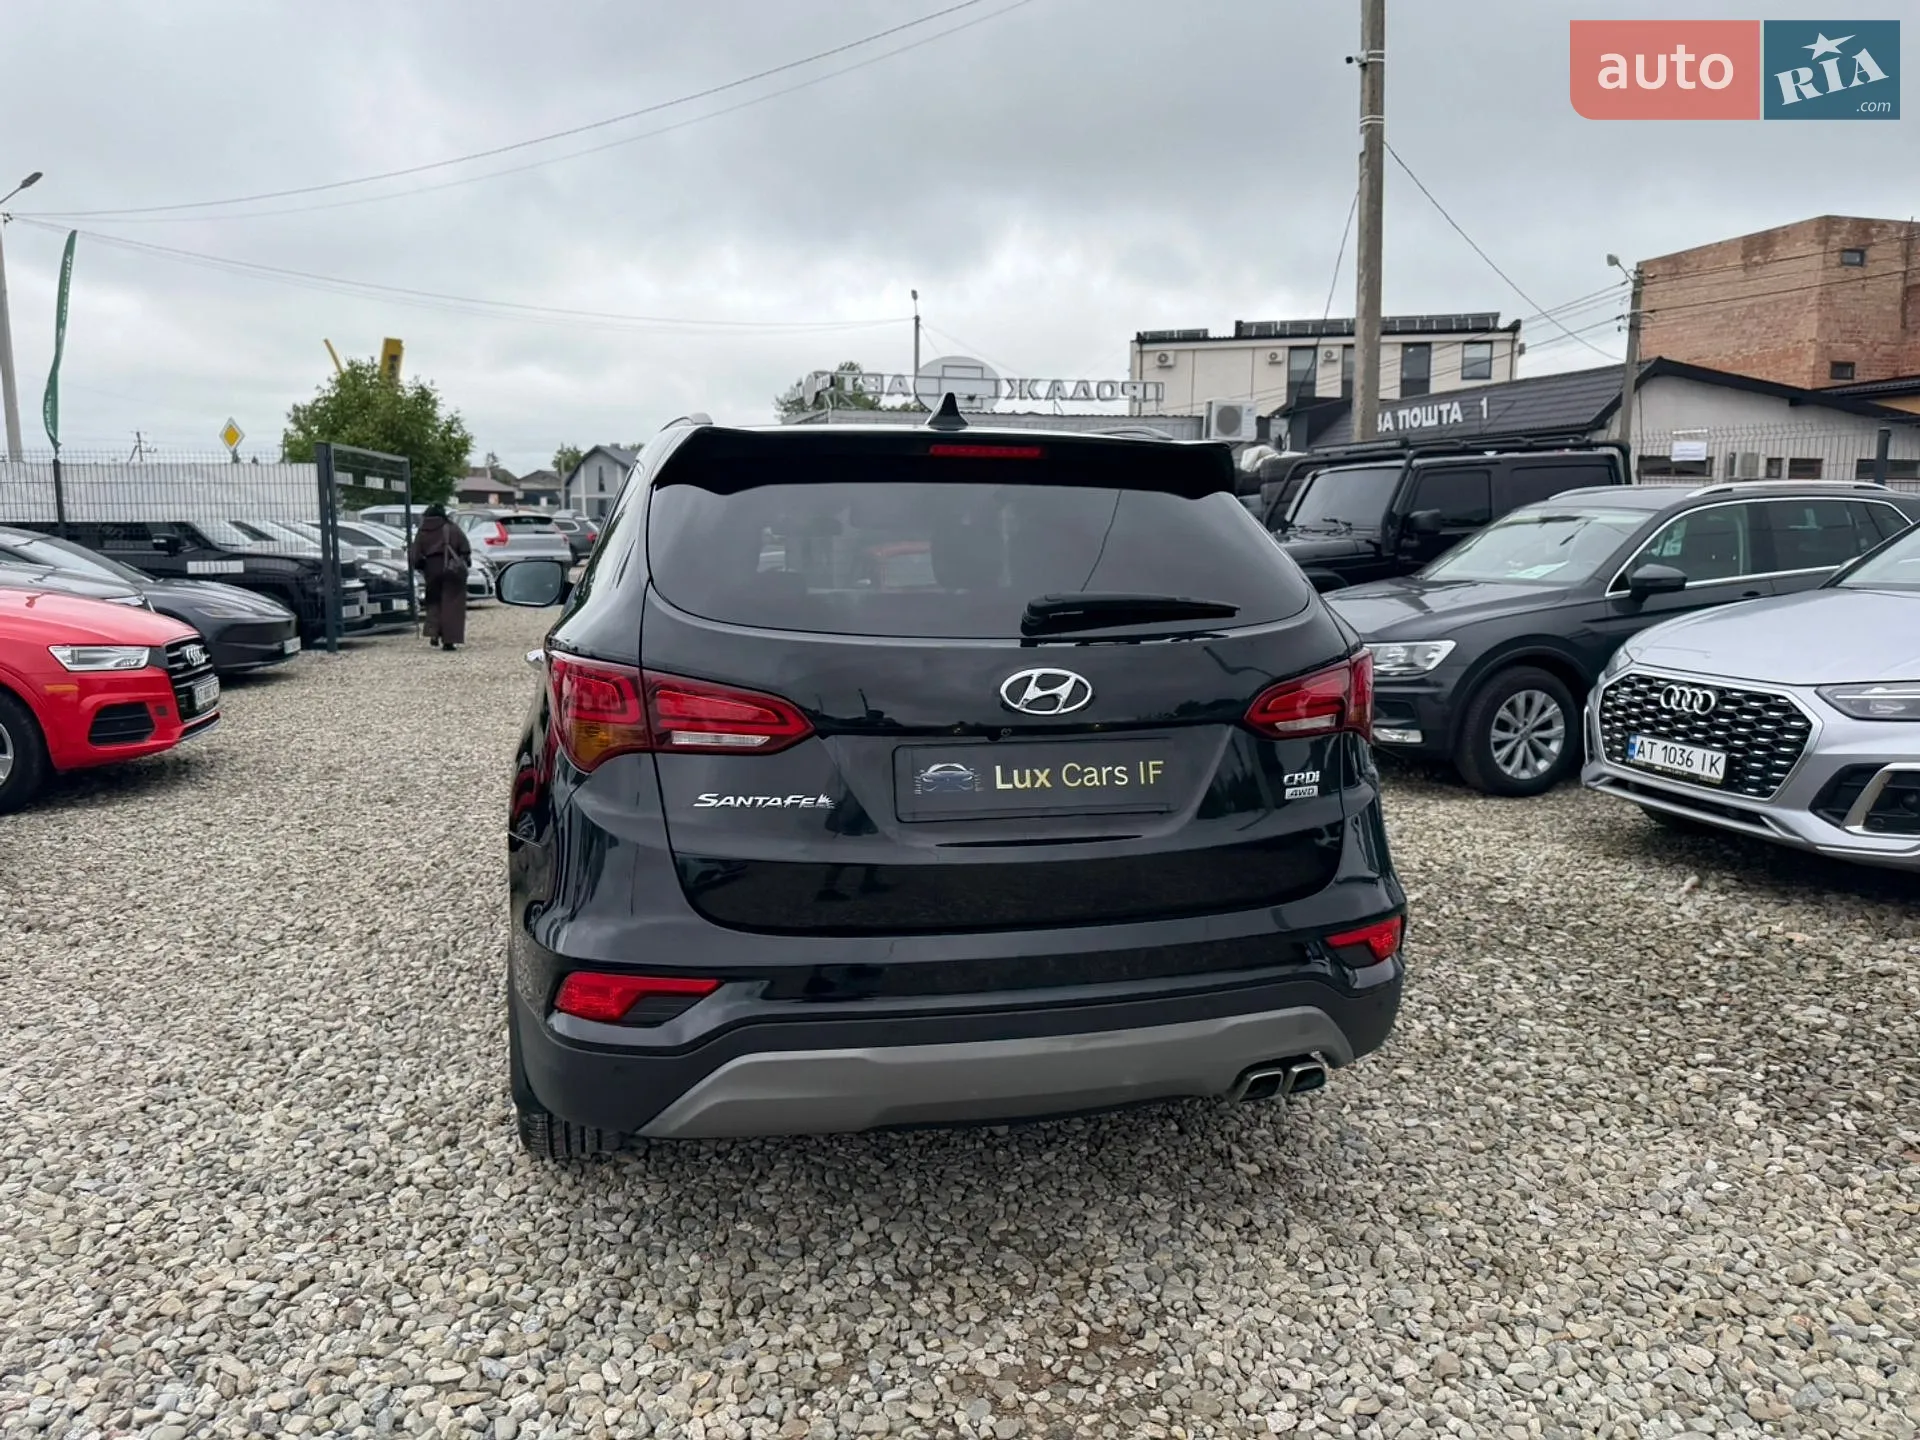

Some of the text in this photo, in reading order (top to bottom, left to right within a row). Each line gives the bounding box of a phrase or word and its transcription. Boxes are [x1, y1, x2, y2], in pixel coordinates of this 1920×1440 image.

[1398, 401, 1463, 430] ПОШТА
[1480, 397, 1488, 419] 1
[995, 760, 1164, 789] Lux Cars IF
[1636, 740, 1657, 760] AT
[1661, 745, 1694, 768] 1036
[1701, 753, 1722, 776] IK
